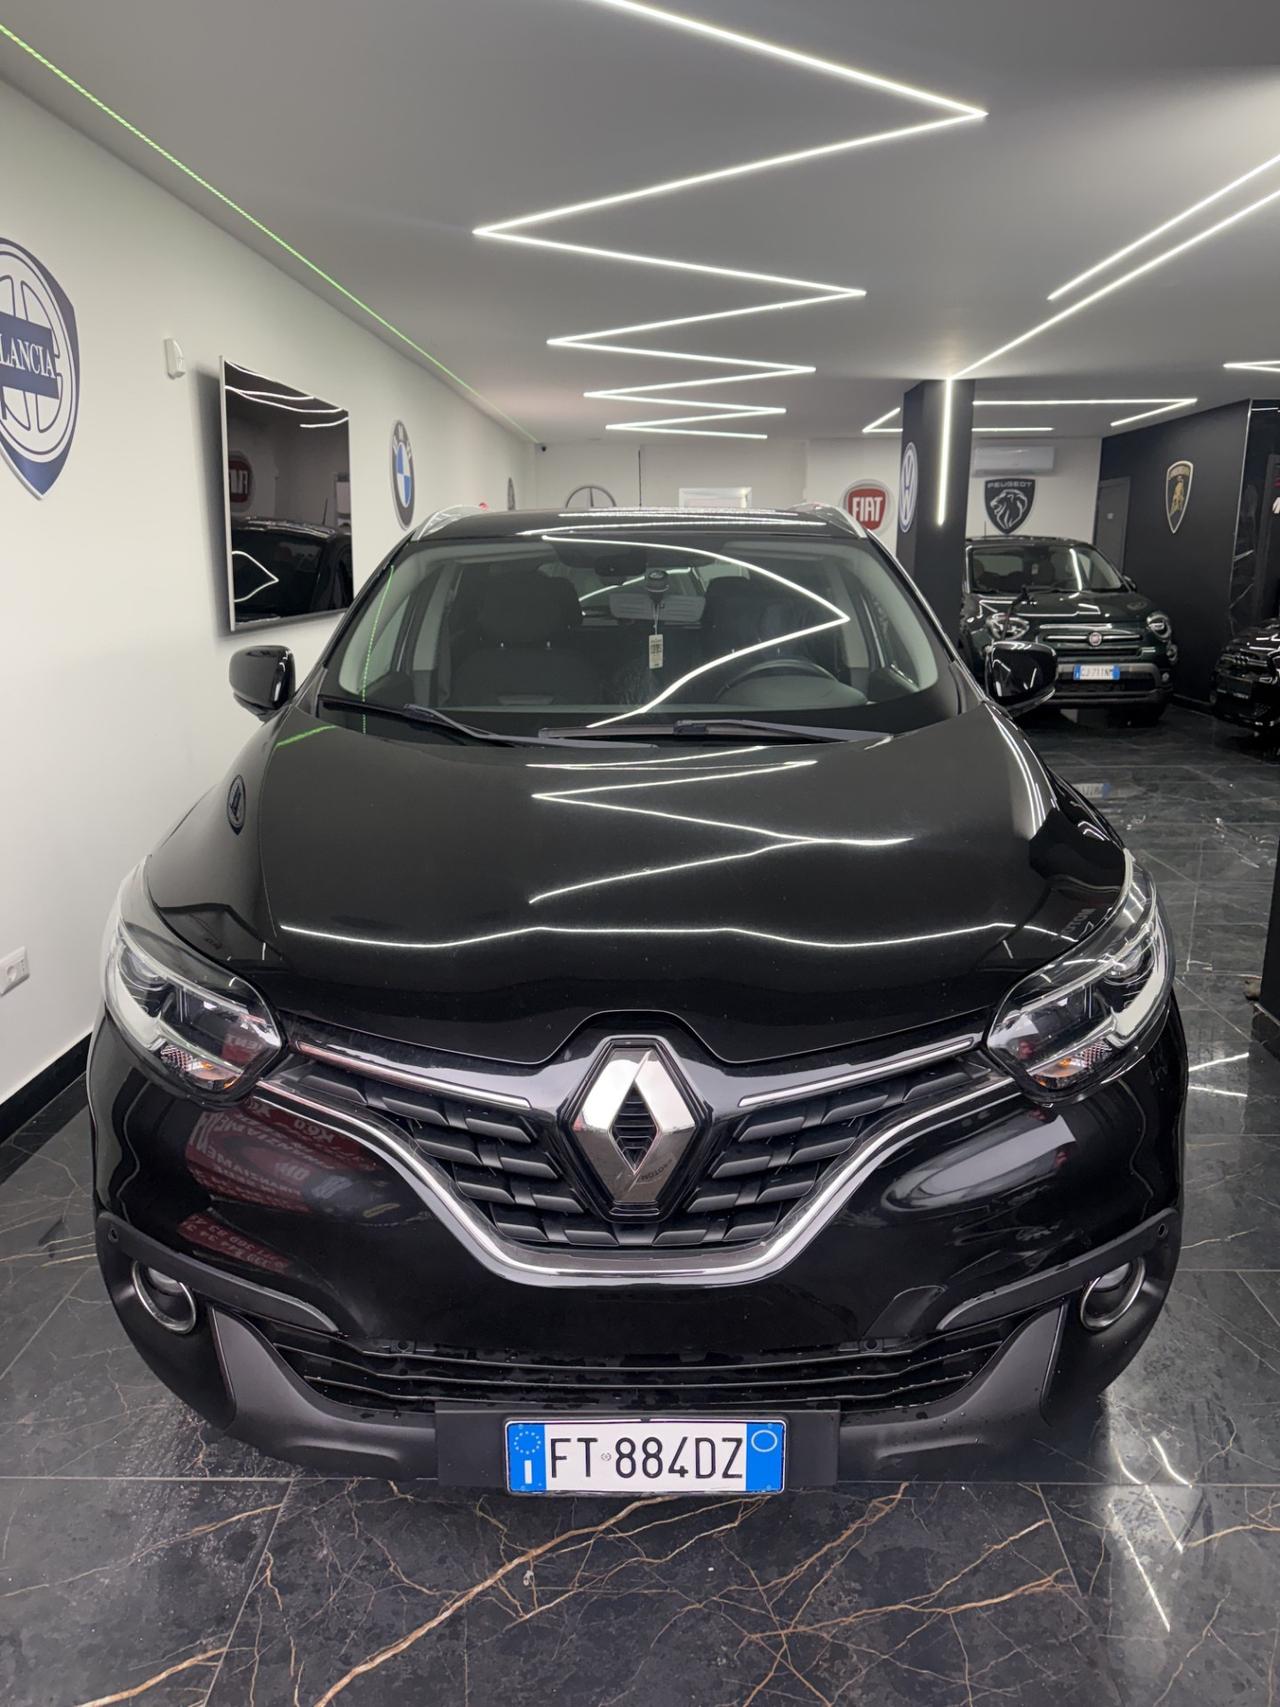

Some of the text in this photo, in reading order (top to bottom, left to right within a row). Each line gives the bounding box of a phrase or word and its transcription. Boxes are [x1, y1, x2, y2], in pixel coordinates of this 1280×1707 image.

[0, 333, 56, 379] LANCIA
[987, 481, 1033, 489] PEUGEOT
[852, 496, 883, 522] FIAT
[550, 1436, 743, 1479] FT 884DZ
